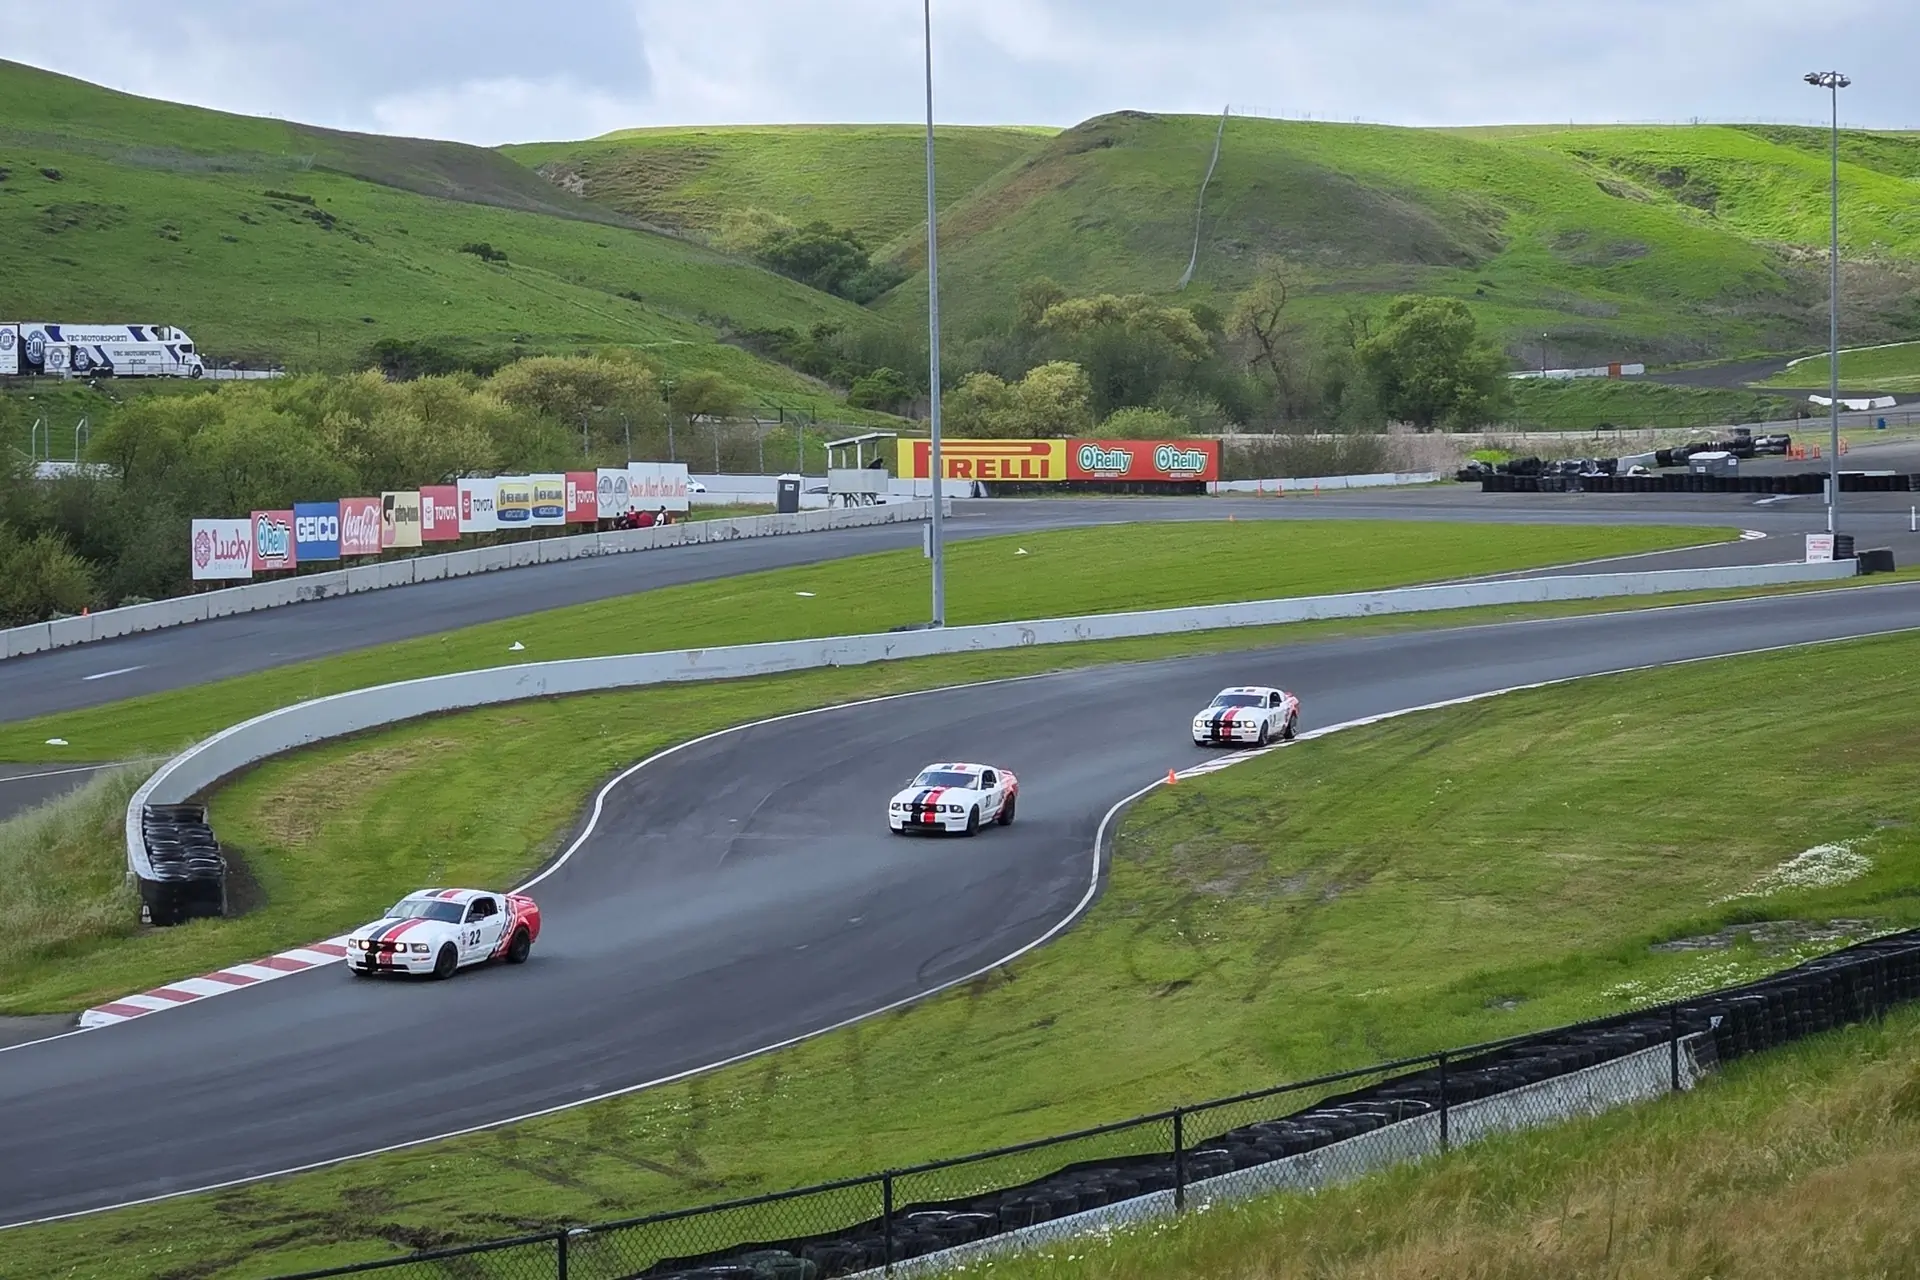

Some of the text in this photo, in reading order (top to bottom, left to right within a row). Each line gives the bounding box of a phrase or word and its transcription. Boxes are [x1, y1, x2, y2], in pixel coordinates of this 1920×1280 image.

[913, 442, 1051, 478] PRELLI
[1079, 444, 1133, 474] O'Reilly
[1155, 444, 1208, 474] O'Reilly
[473, 499, 494, 512] TOYOTA
[577, 490, 595, 504] TOYOTA
[435, 506, 457, 520] TOYOTA
[295, 516, 339, 542] GEICO
[212, 528, 250, 569] Lucky
[469, 929, 481, 946] 22
